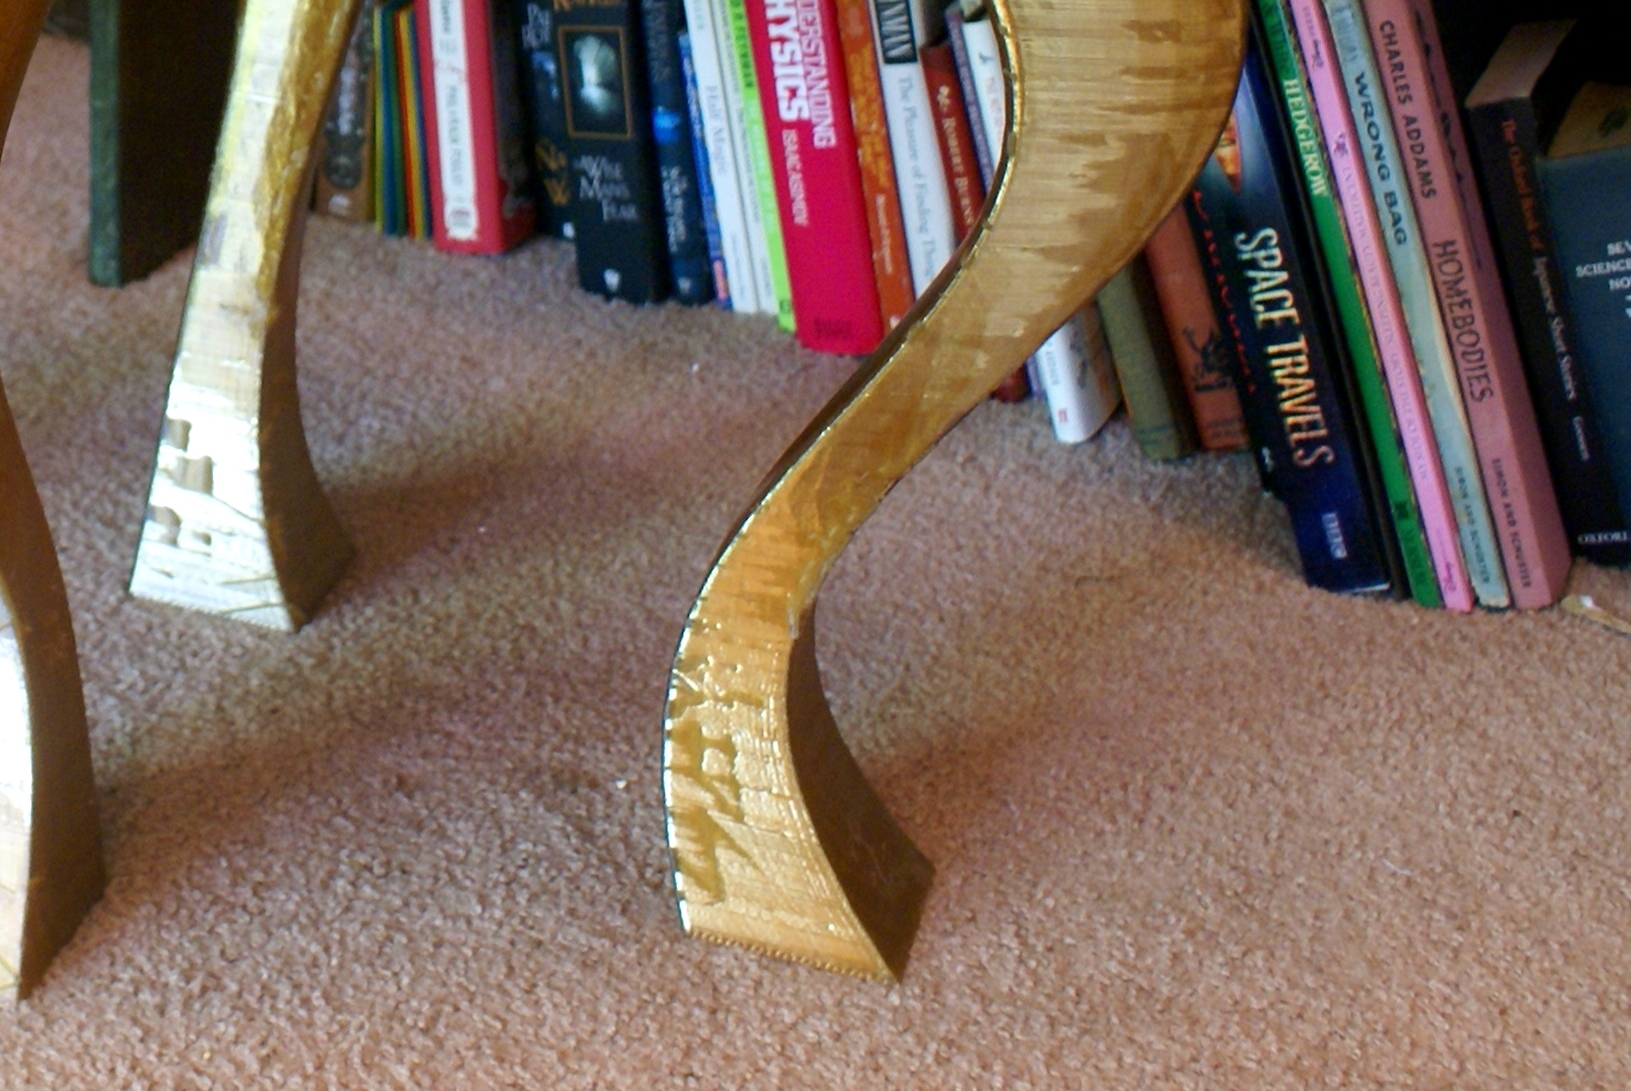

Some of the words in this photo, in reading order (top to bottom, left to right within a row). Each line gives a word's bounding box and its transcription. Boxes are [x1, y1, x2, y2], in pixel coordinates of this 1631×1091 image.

[898, 76, 916, 104] The
[901, 107, 926, 160] Pleasure
[941, 116, 965, 174] ROBERT
[1283, 76, 1329, 199] HEDGEROW
[1378, 19, 1413, 107] CHARLES
[1400, 113, 1438, 201] ADDAMS
[780, 128, 799, 171] ISAAC
[1351, 71, 1394, 184] WRONG
[1379, 185, 1408, 247] BAG
[1234, 226, 1299, 331] SPACE
[1432, 240, 1494, 405] HOMEBODIES
[1265, 333, 1336, 469] TRAVELS
